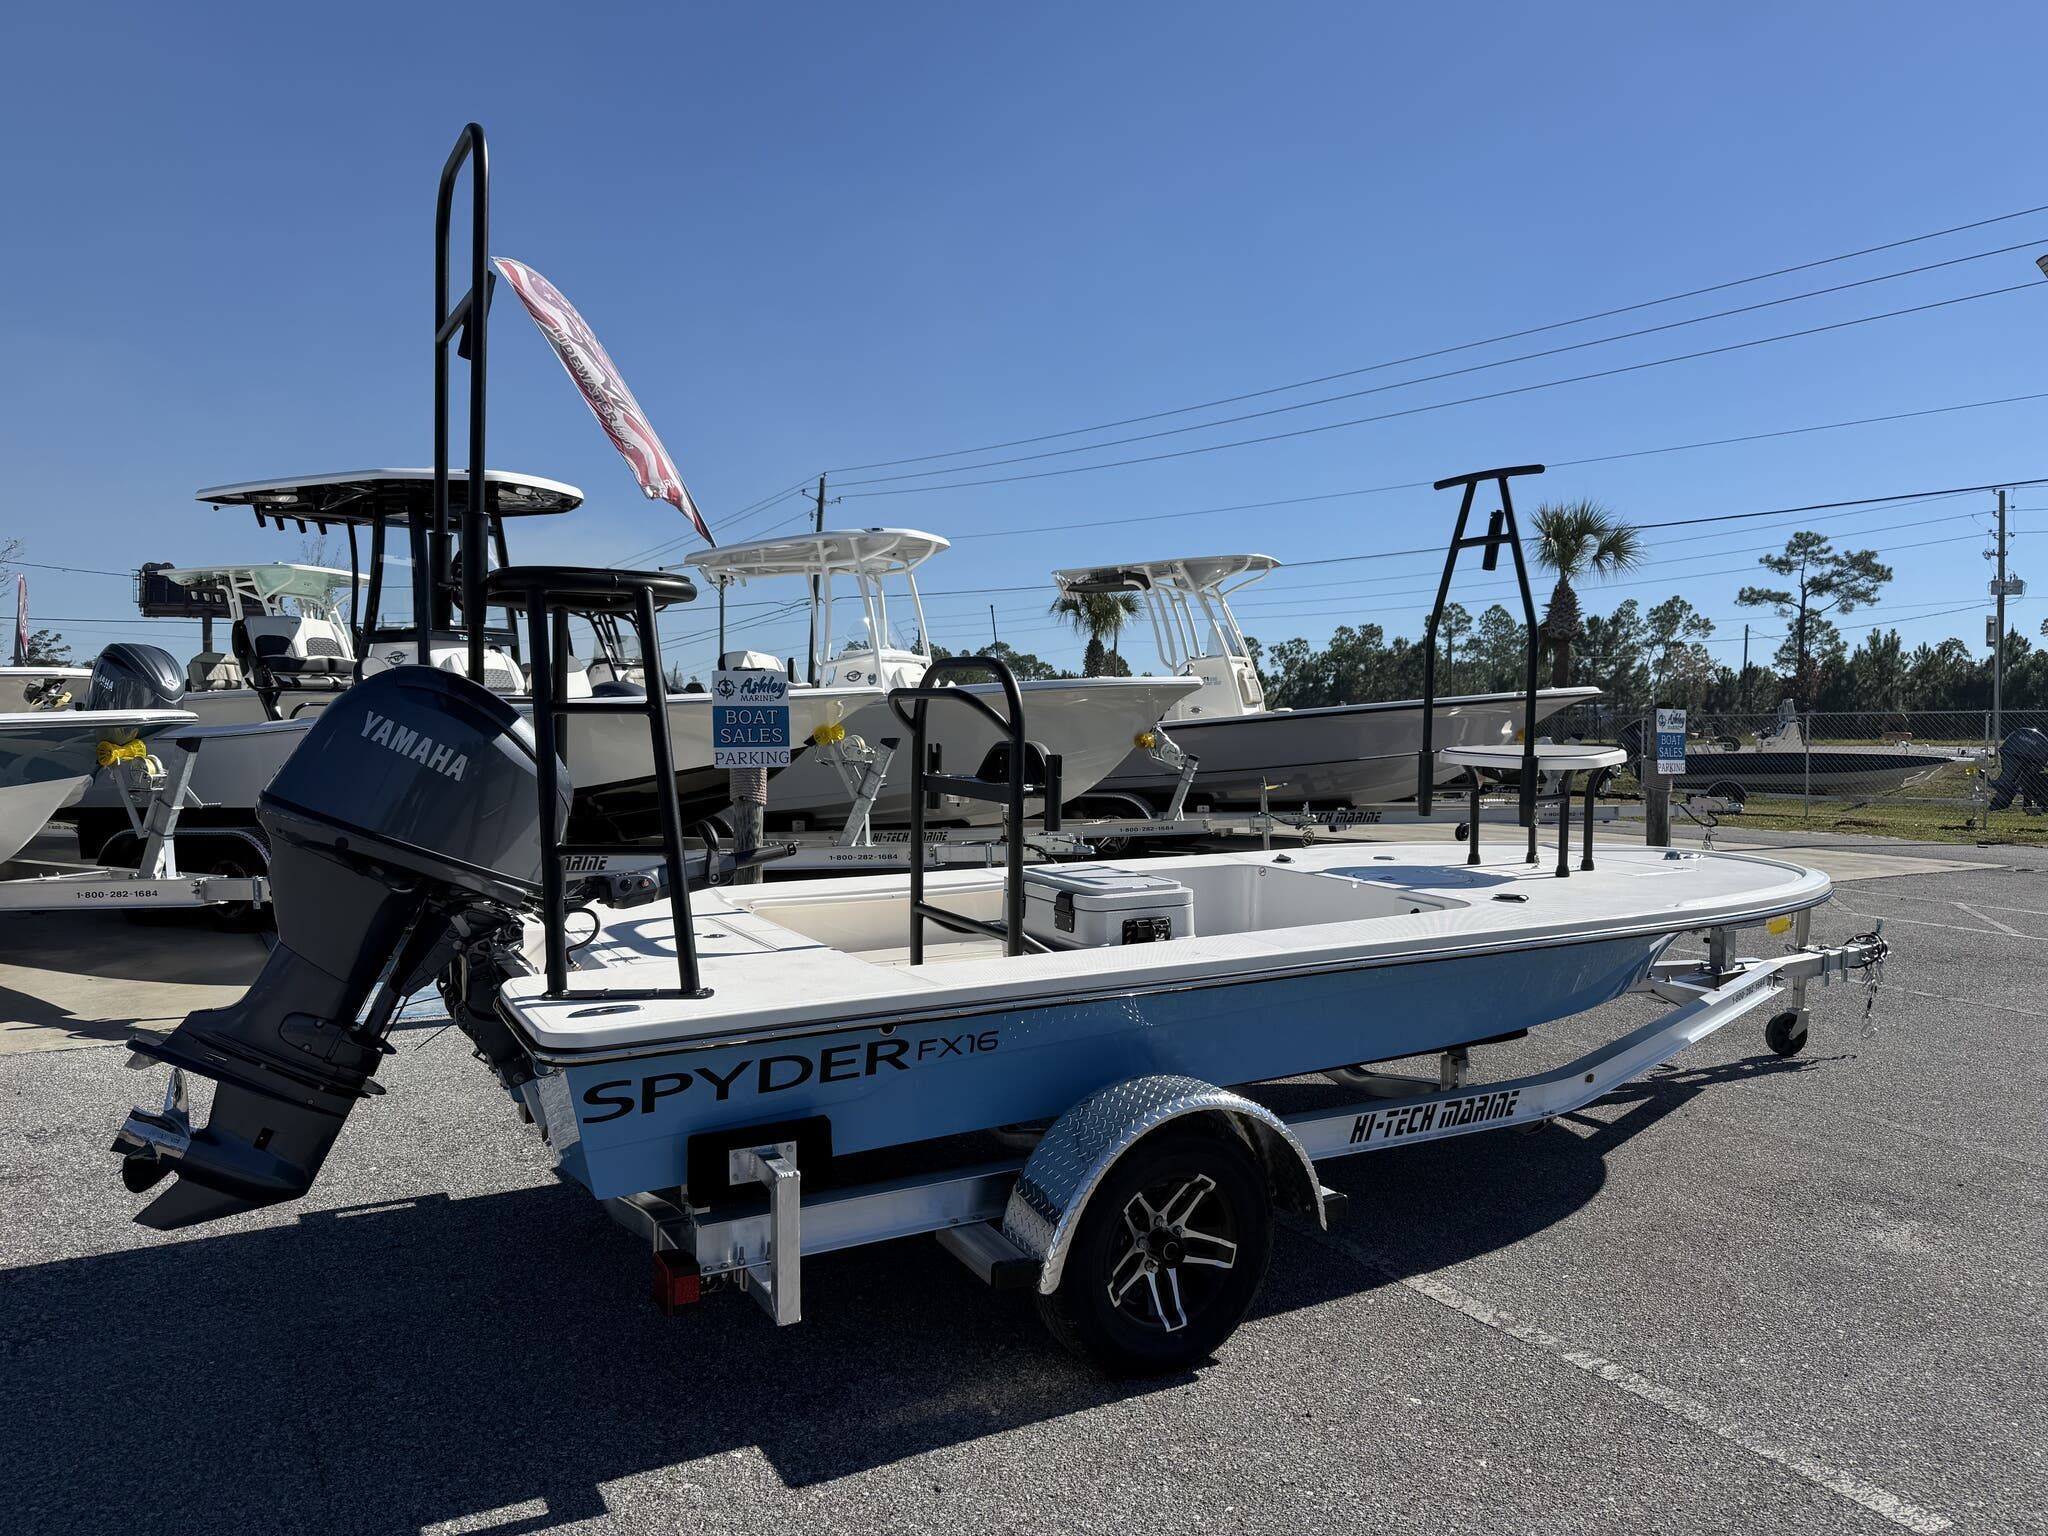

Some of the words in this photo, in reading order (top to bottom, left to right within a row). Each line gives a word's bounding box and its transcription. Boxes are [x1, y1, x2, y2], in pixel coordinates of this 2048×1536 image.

[740, 675, 787, 699] Ashley
[740, 694, 775, 702] MARINE
[725, 709, 778, 725] BOAT
[720, 728, 783, 743] SALES
[1661, 735, 1682, 745] BOAT
[361, 710, 468, 782] YAMAHA
[715, 751, 790, 765] PARKING
[1659, 747, 1683, 758] SALES
[1336, 812, 1382, 823] MARINE
[872, 832, 909, 843] HI-TECH
[829, 853, 898, 861] 1-800-282-1684
[77, 889, 158, 899] 1-800-282-1684
[582, 1038, 911, 1124] SPYDER
[917, 1030, 1001, 1061] FX16
[1349, 1103, 1438, 1145] HI-TECH
[1438, 1089, 1521, 1129] MARINE
